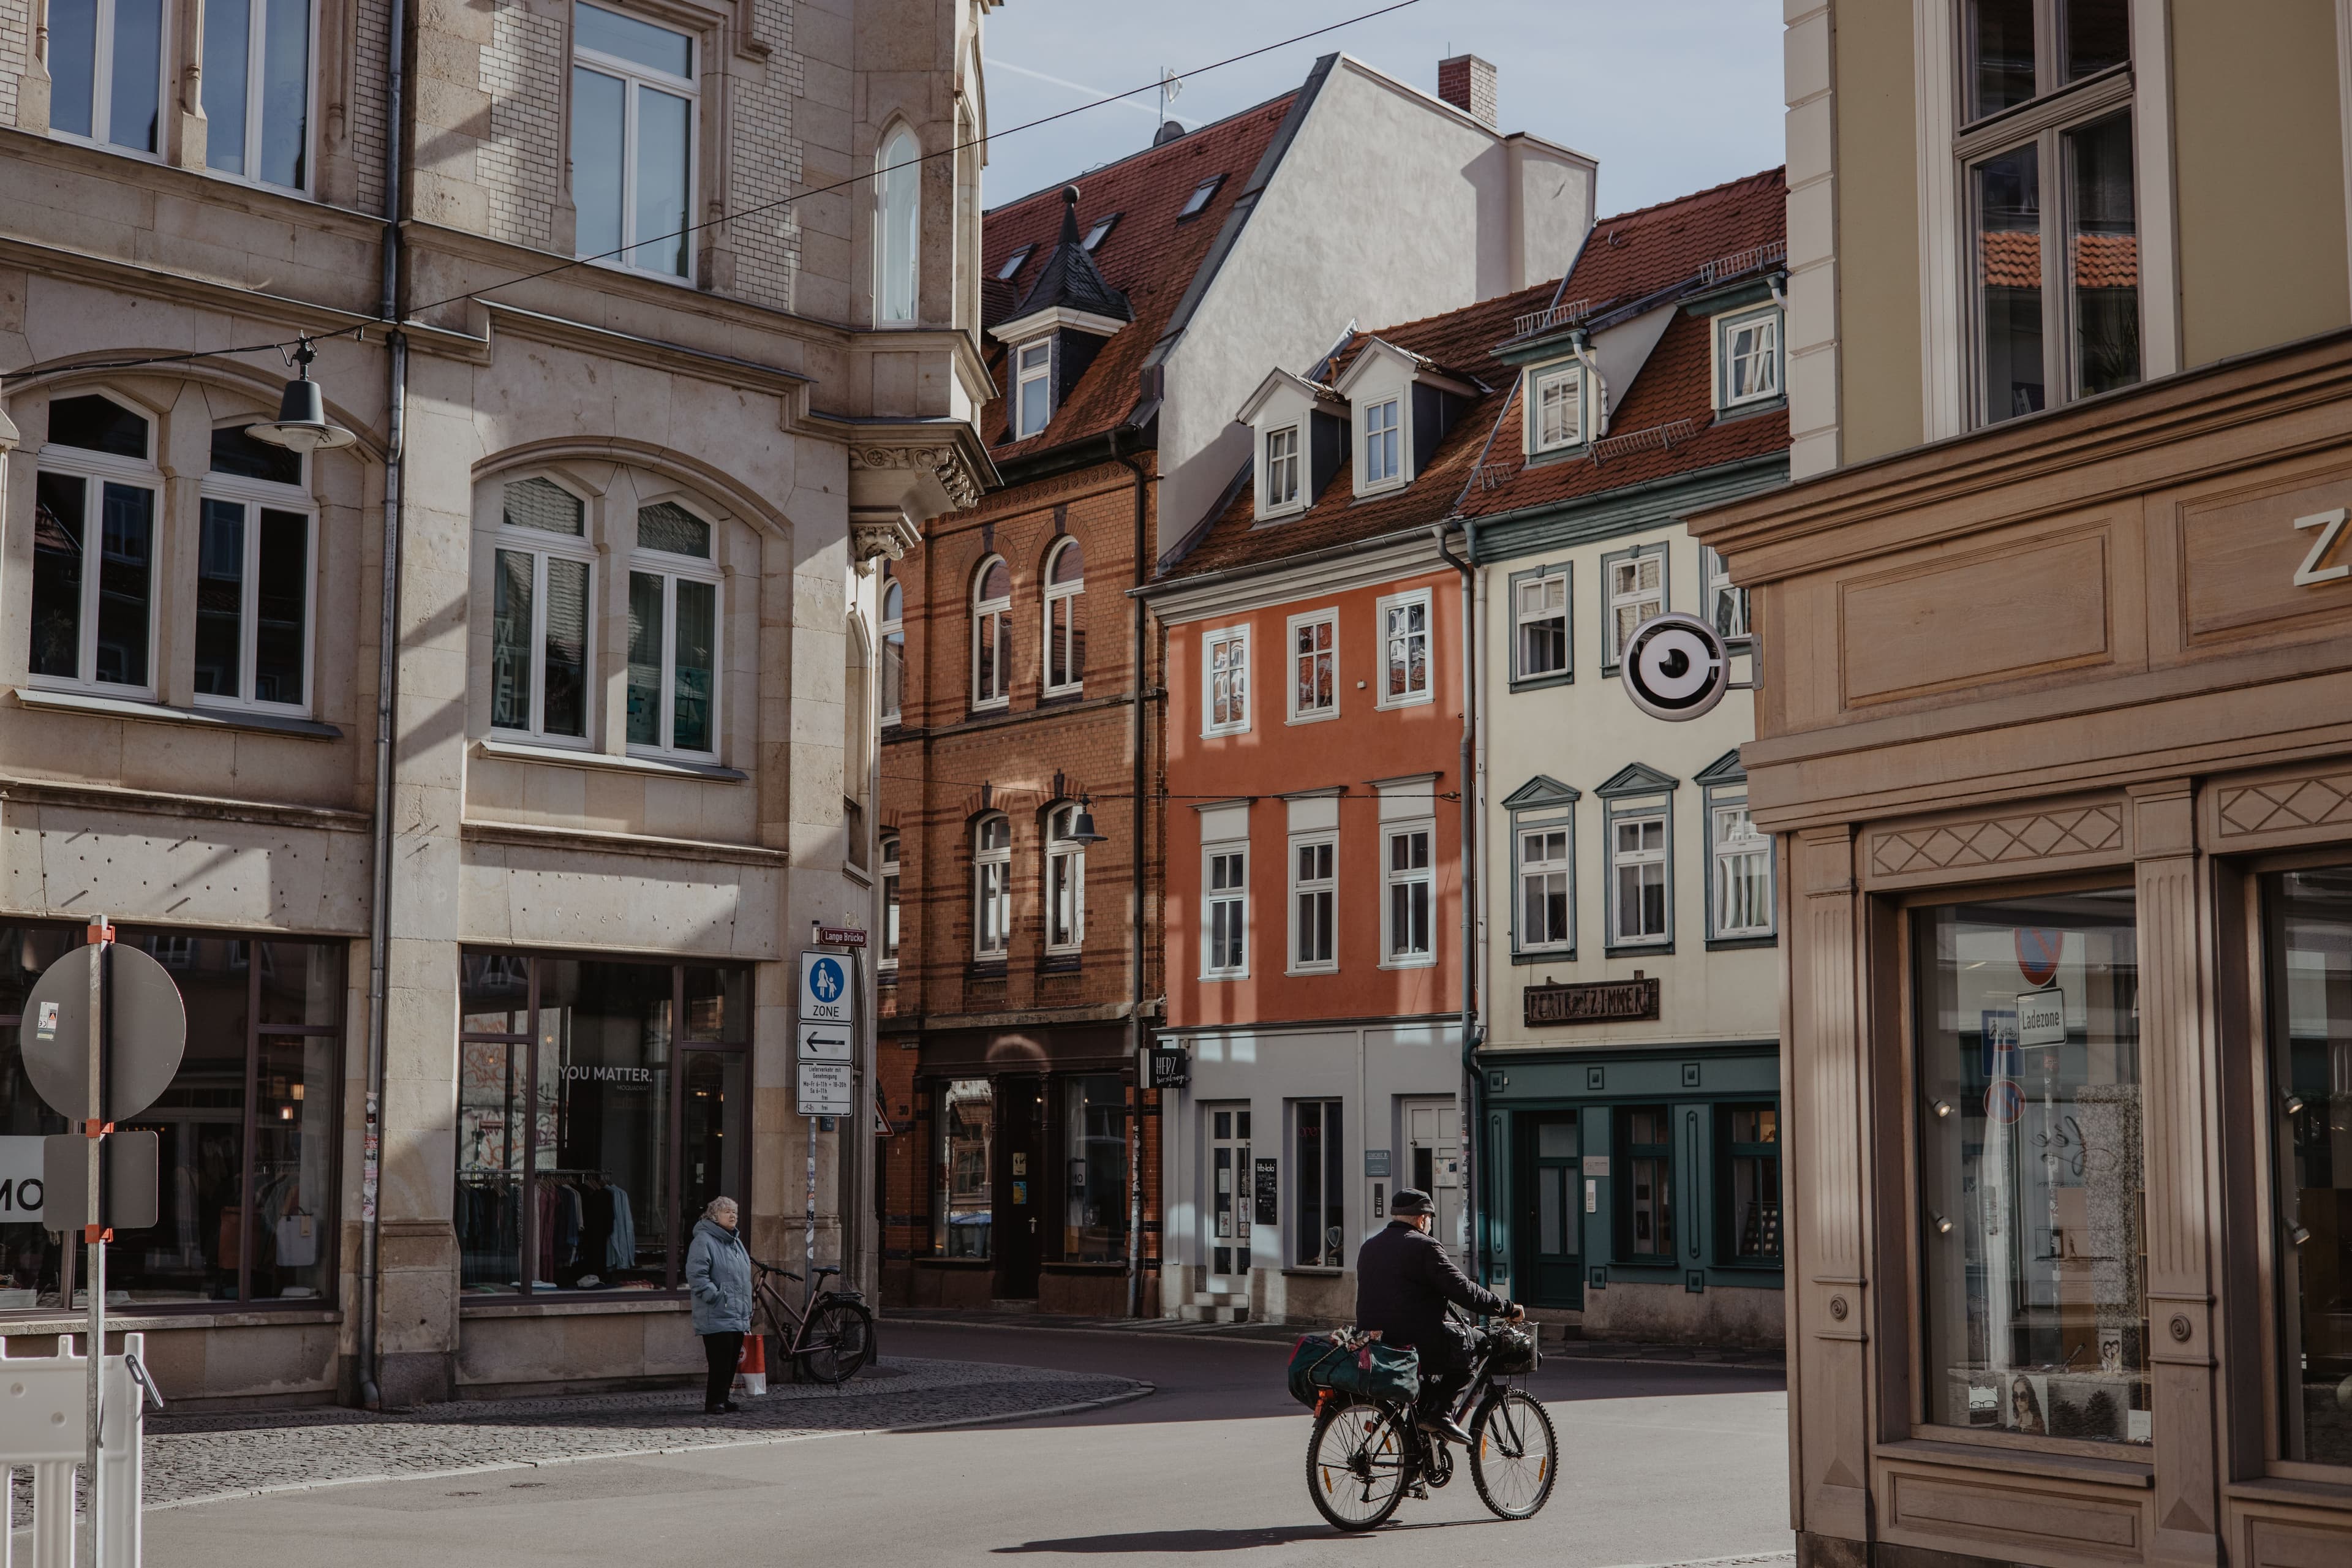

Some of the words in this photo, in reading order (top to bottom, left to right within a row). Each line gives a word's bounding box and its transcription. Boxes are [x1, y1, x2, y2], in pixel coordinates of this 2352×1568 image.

[494, 617, 514, 723] MALEN
[825, 931, 843, 943] Lange
[844, 932, 864, 943] Brücke
[813, 1005, 839, 1017] ZONE
[2022, 1009, 2059, 1030] Ladezone
[559, 1066, 589, 1080] YOU
[594, 1066, 652, 1082] MATTER.
[1156, 1057, 1177, 1075] HERZ
